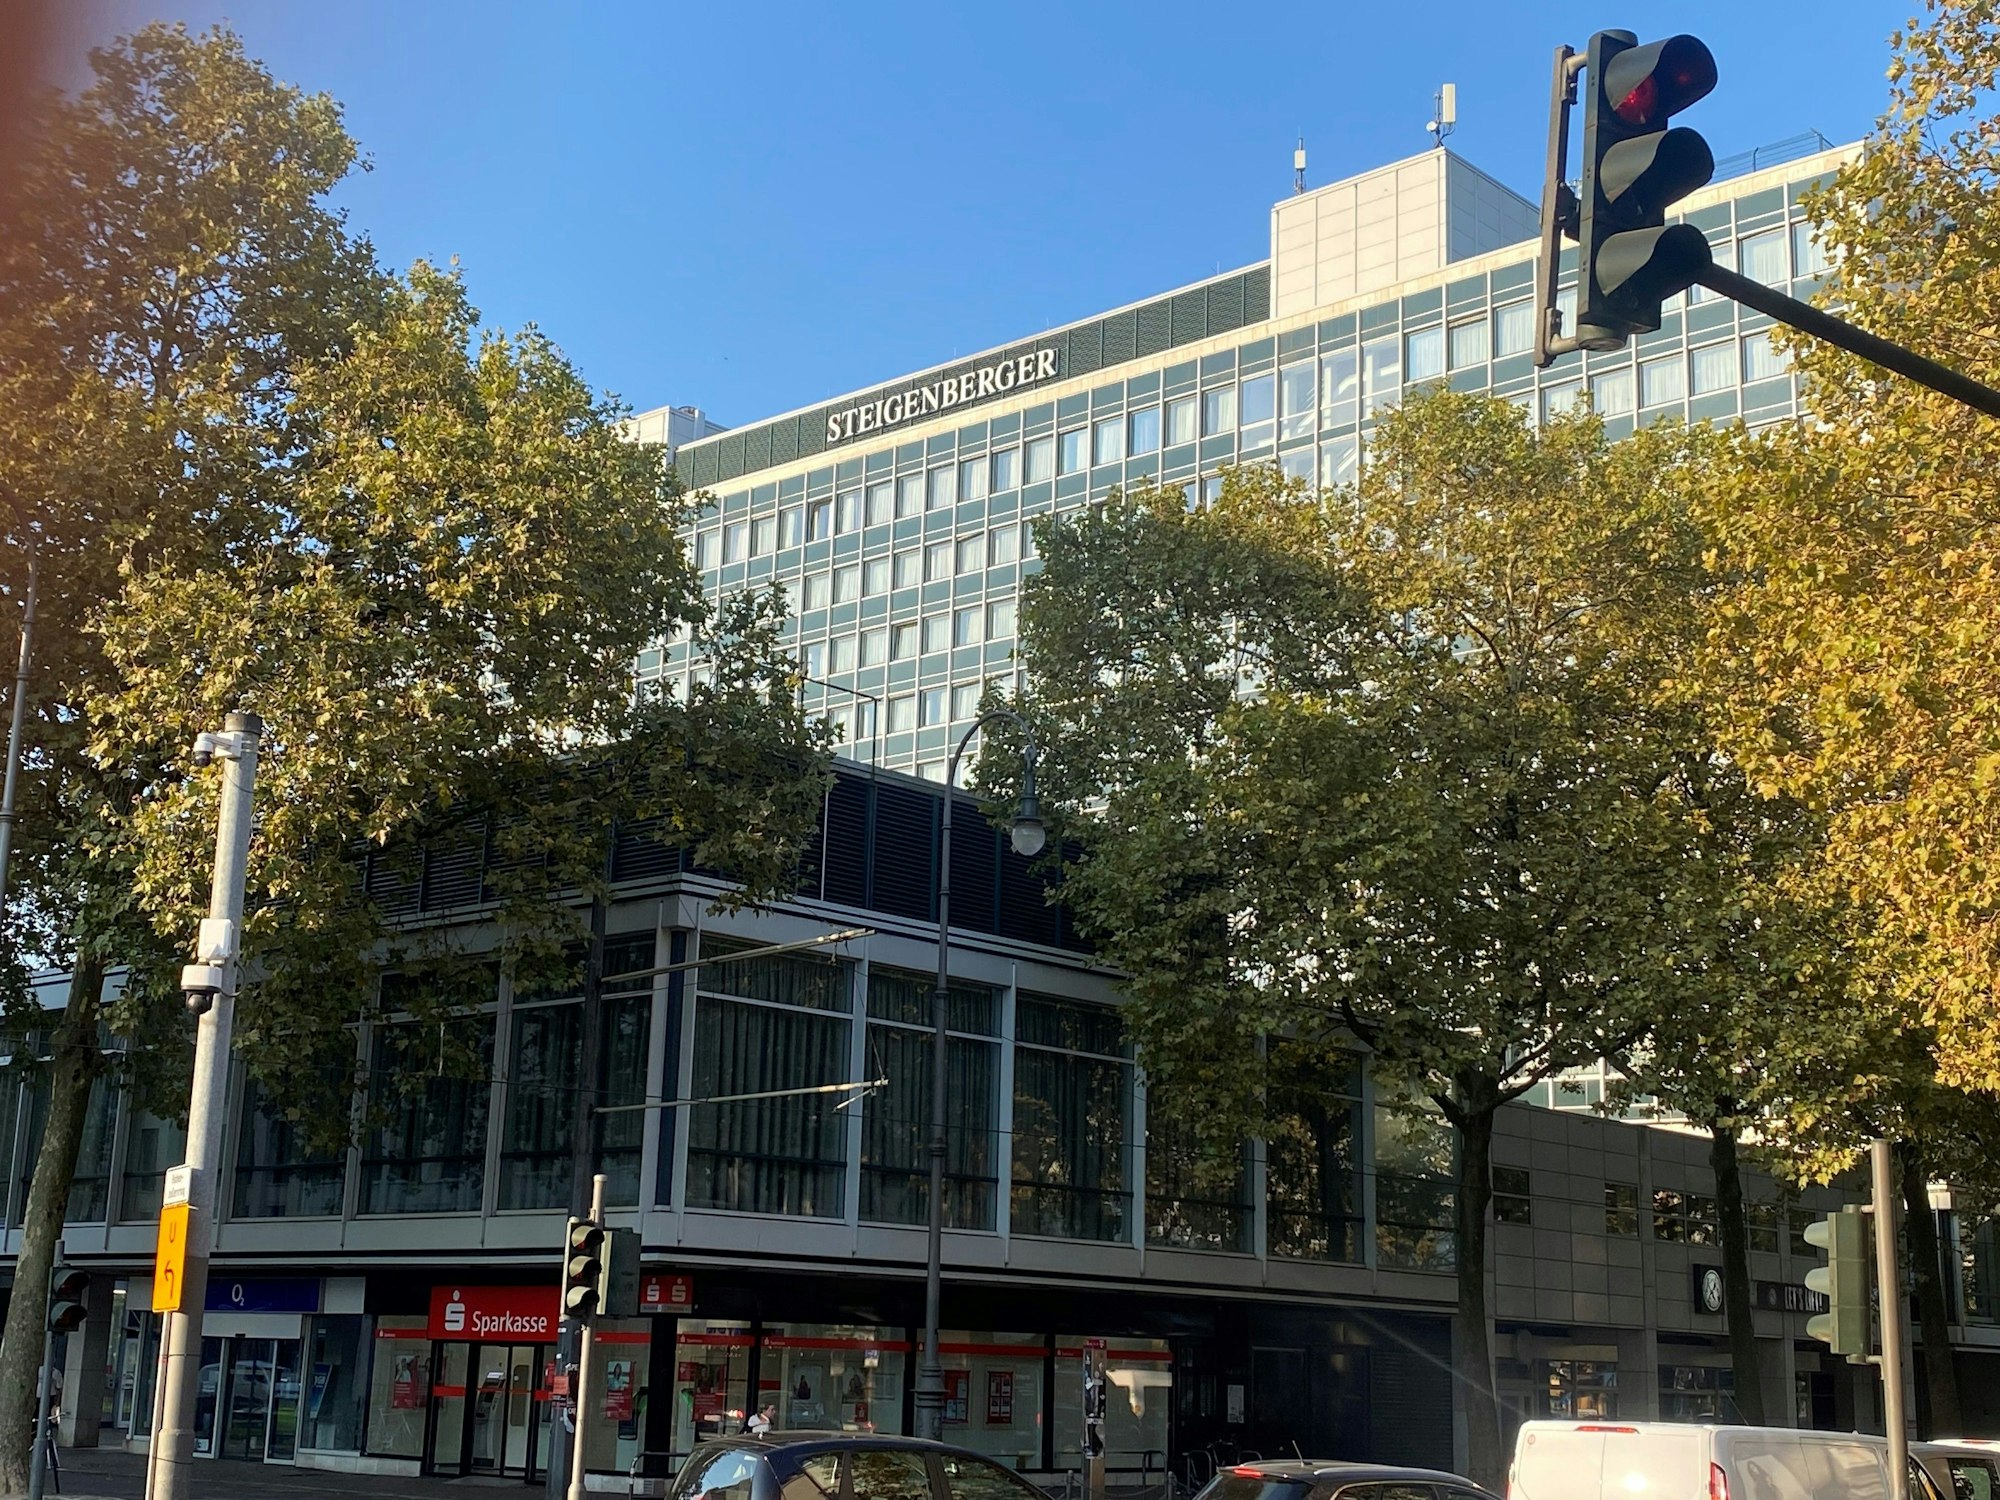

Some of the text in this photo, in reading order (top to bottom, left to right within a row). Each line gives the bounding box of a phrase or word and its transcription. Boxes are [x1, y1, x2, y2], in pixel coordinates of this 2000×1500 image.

[826, 348, 1059, 443] STEIGENBERGER
[169, 1221, 177, 1244] U
[471, 1310, 548, 1337] Sparkasse
